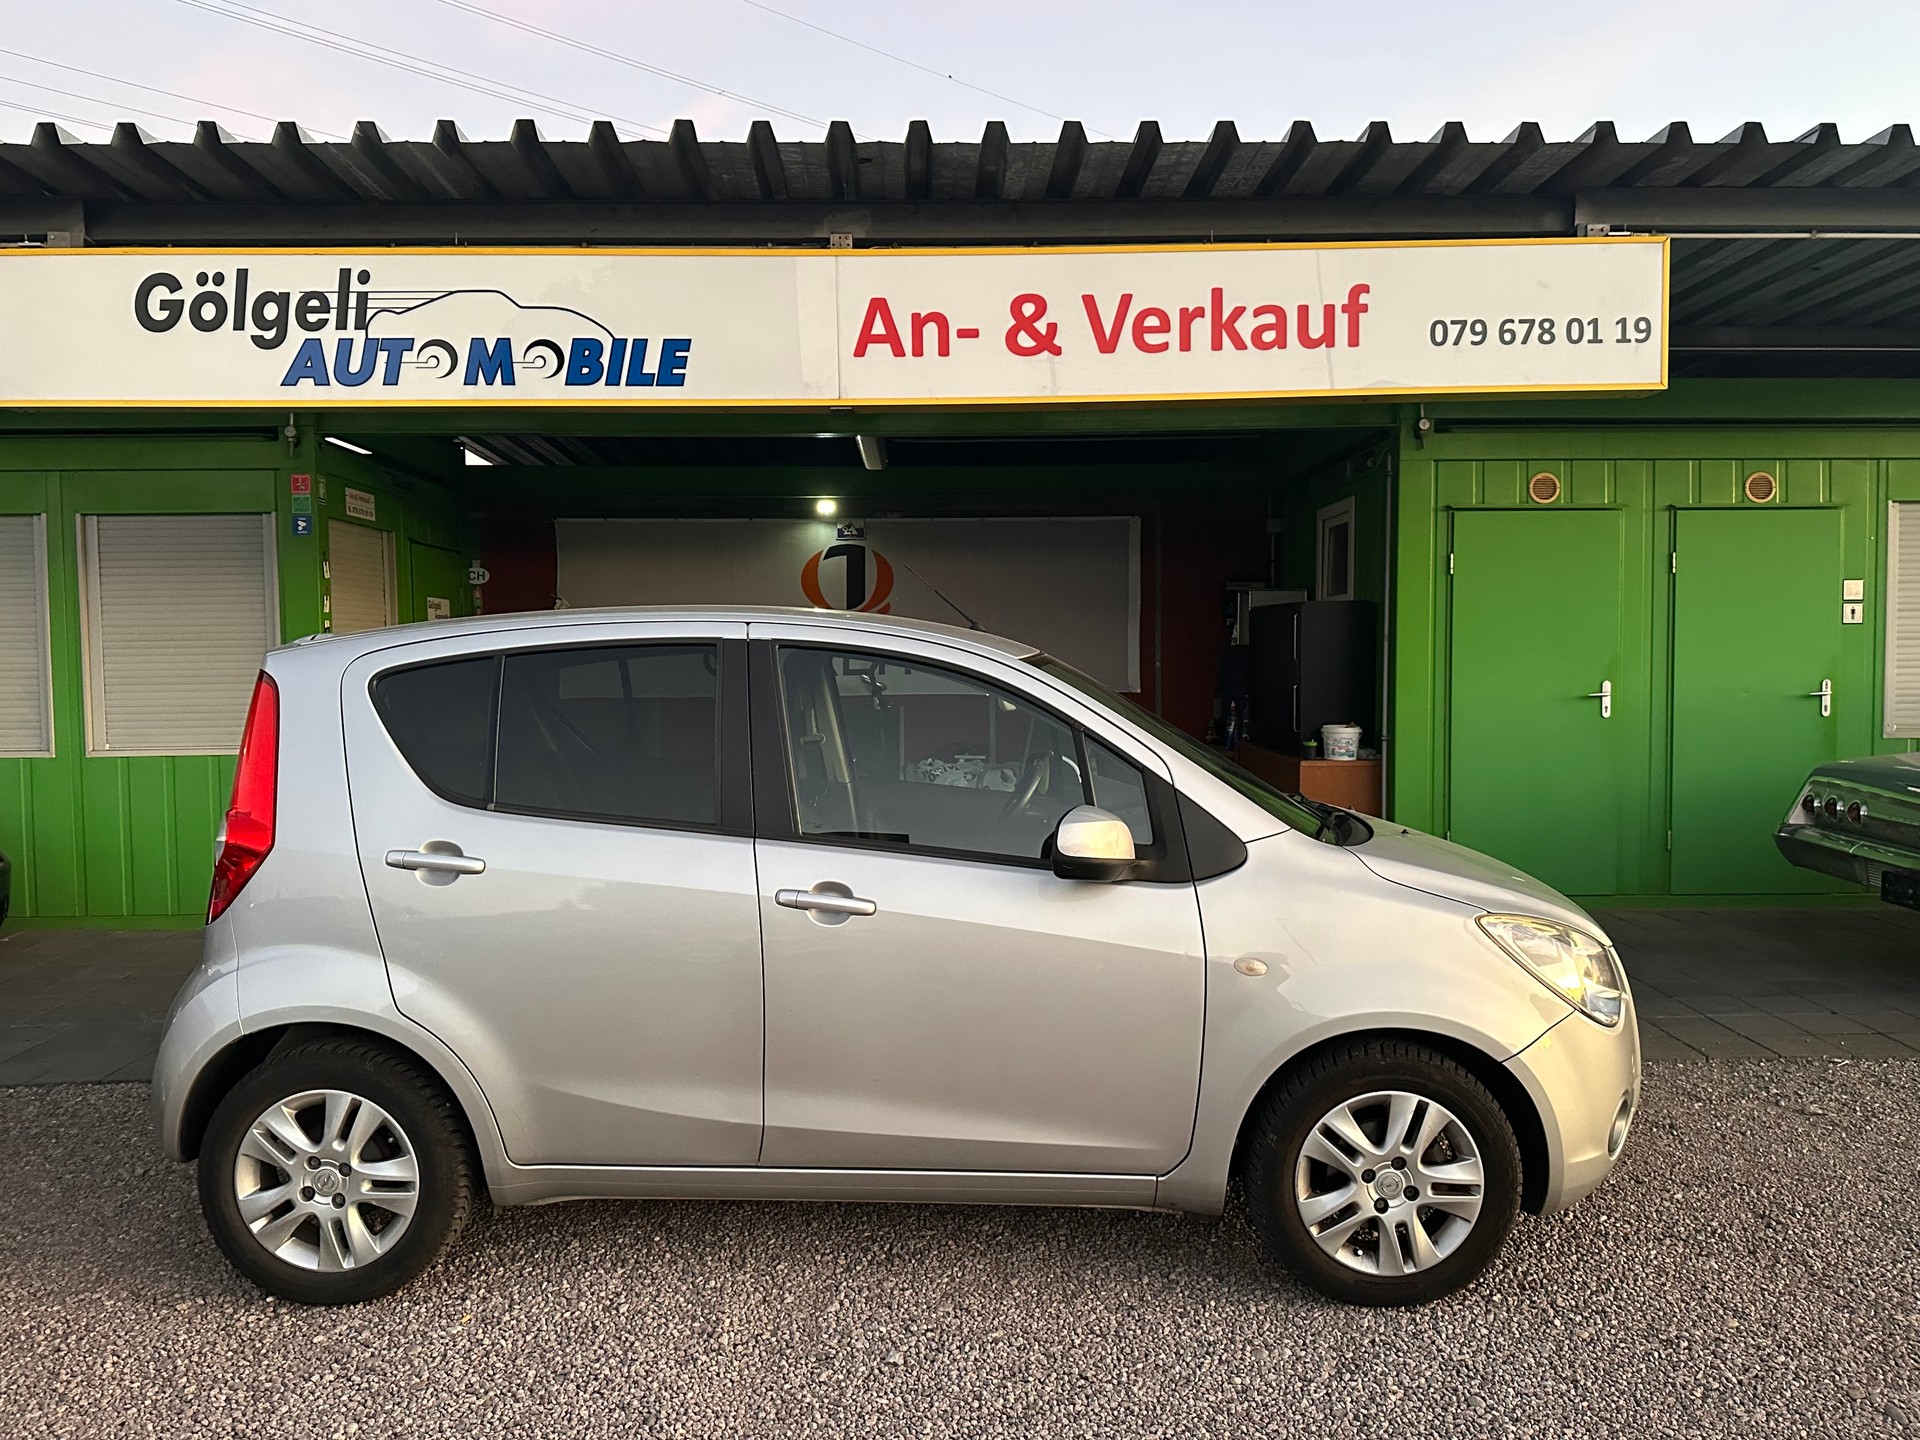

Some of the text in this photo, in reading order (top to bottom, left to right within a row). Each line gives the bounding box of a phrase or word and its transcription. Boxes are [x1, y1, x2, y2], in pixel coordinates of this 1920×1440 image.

[135, 268, 370, 350] Gölgeli
[853, 284, 1371, 358] An- & Verkauf
[1429, 316, 1652, 346] 079 678 01 19
[468, 570, 486, 581] CH
